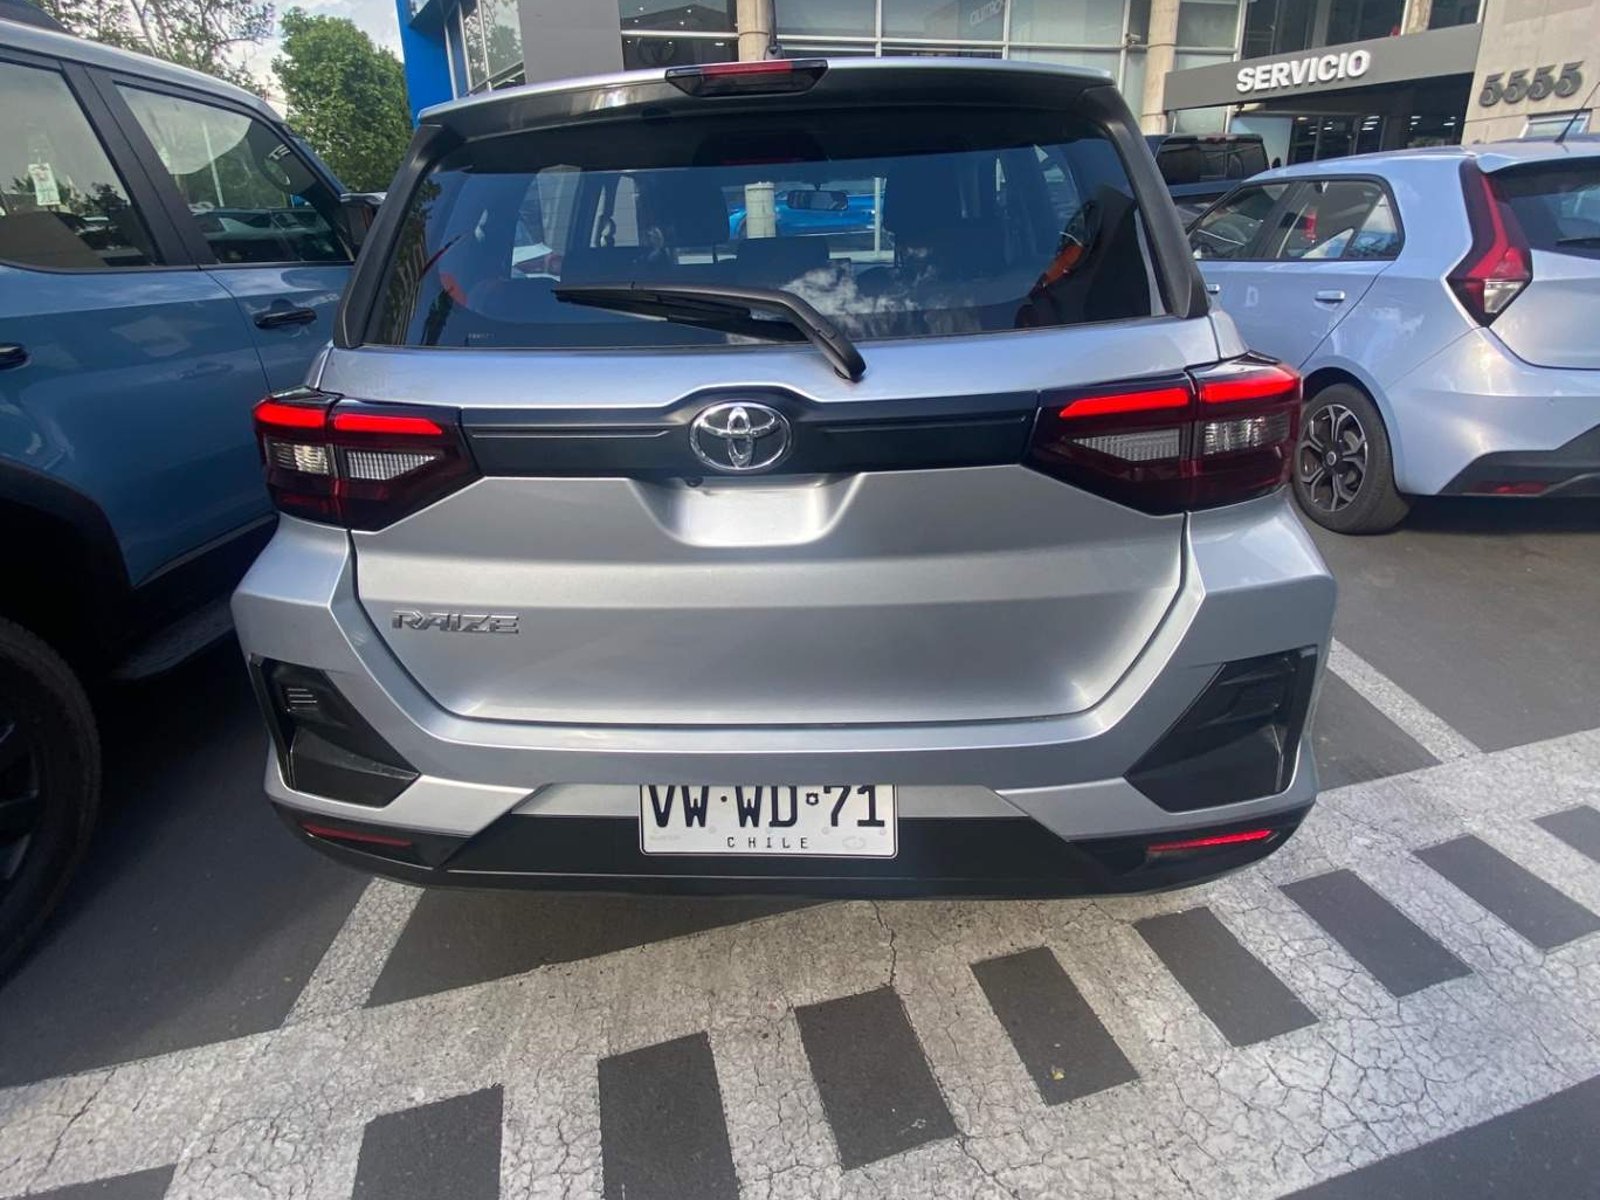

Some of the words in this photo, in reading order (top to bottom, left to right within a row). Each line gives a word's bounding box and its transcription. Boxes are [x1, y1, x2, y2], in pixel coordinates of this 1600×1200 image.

[1236, 50, 1370, 94] SERVICIO
[1479, 61, 1585, 107] 5555
[392, 610, 520, 633] RAIZE
[726, 836, 809, 849] CHILE
